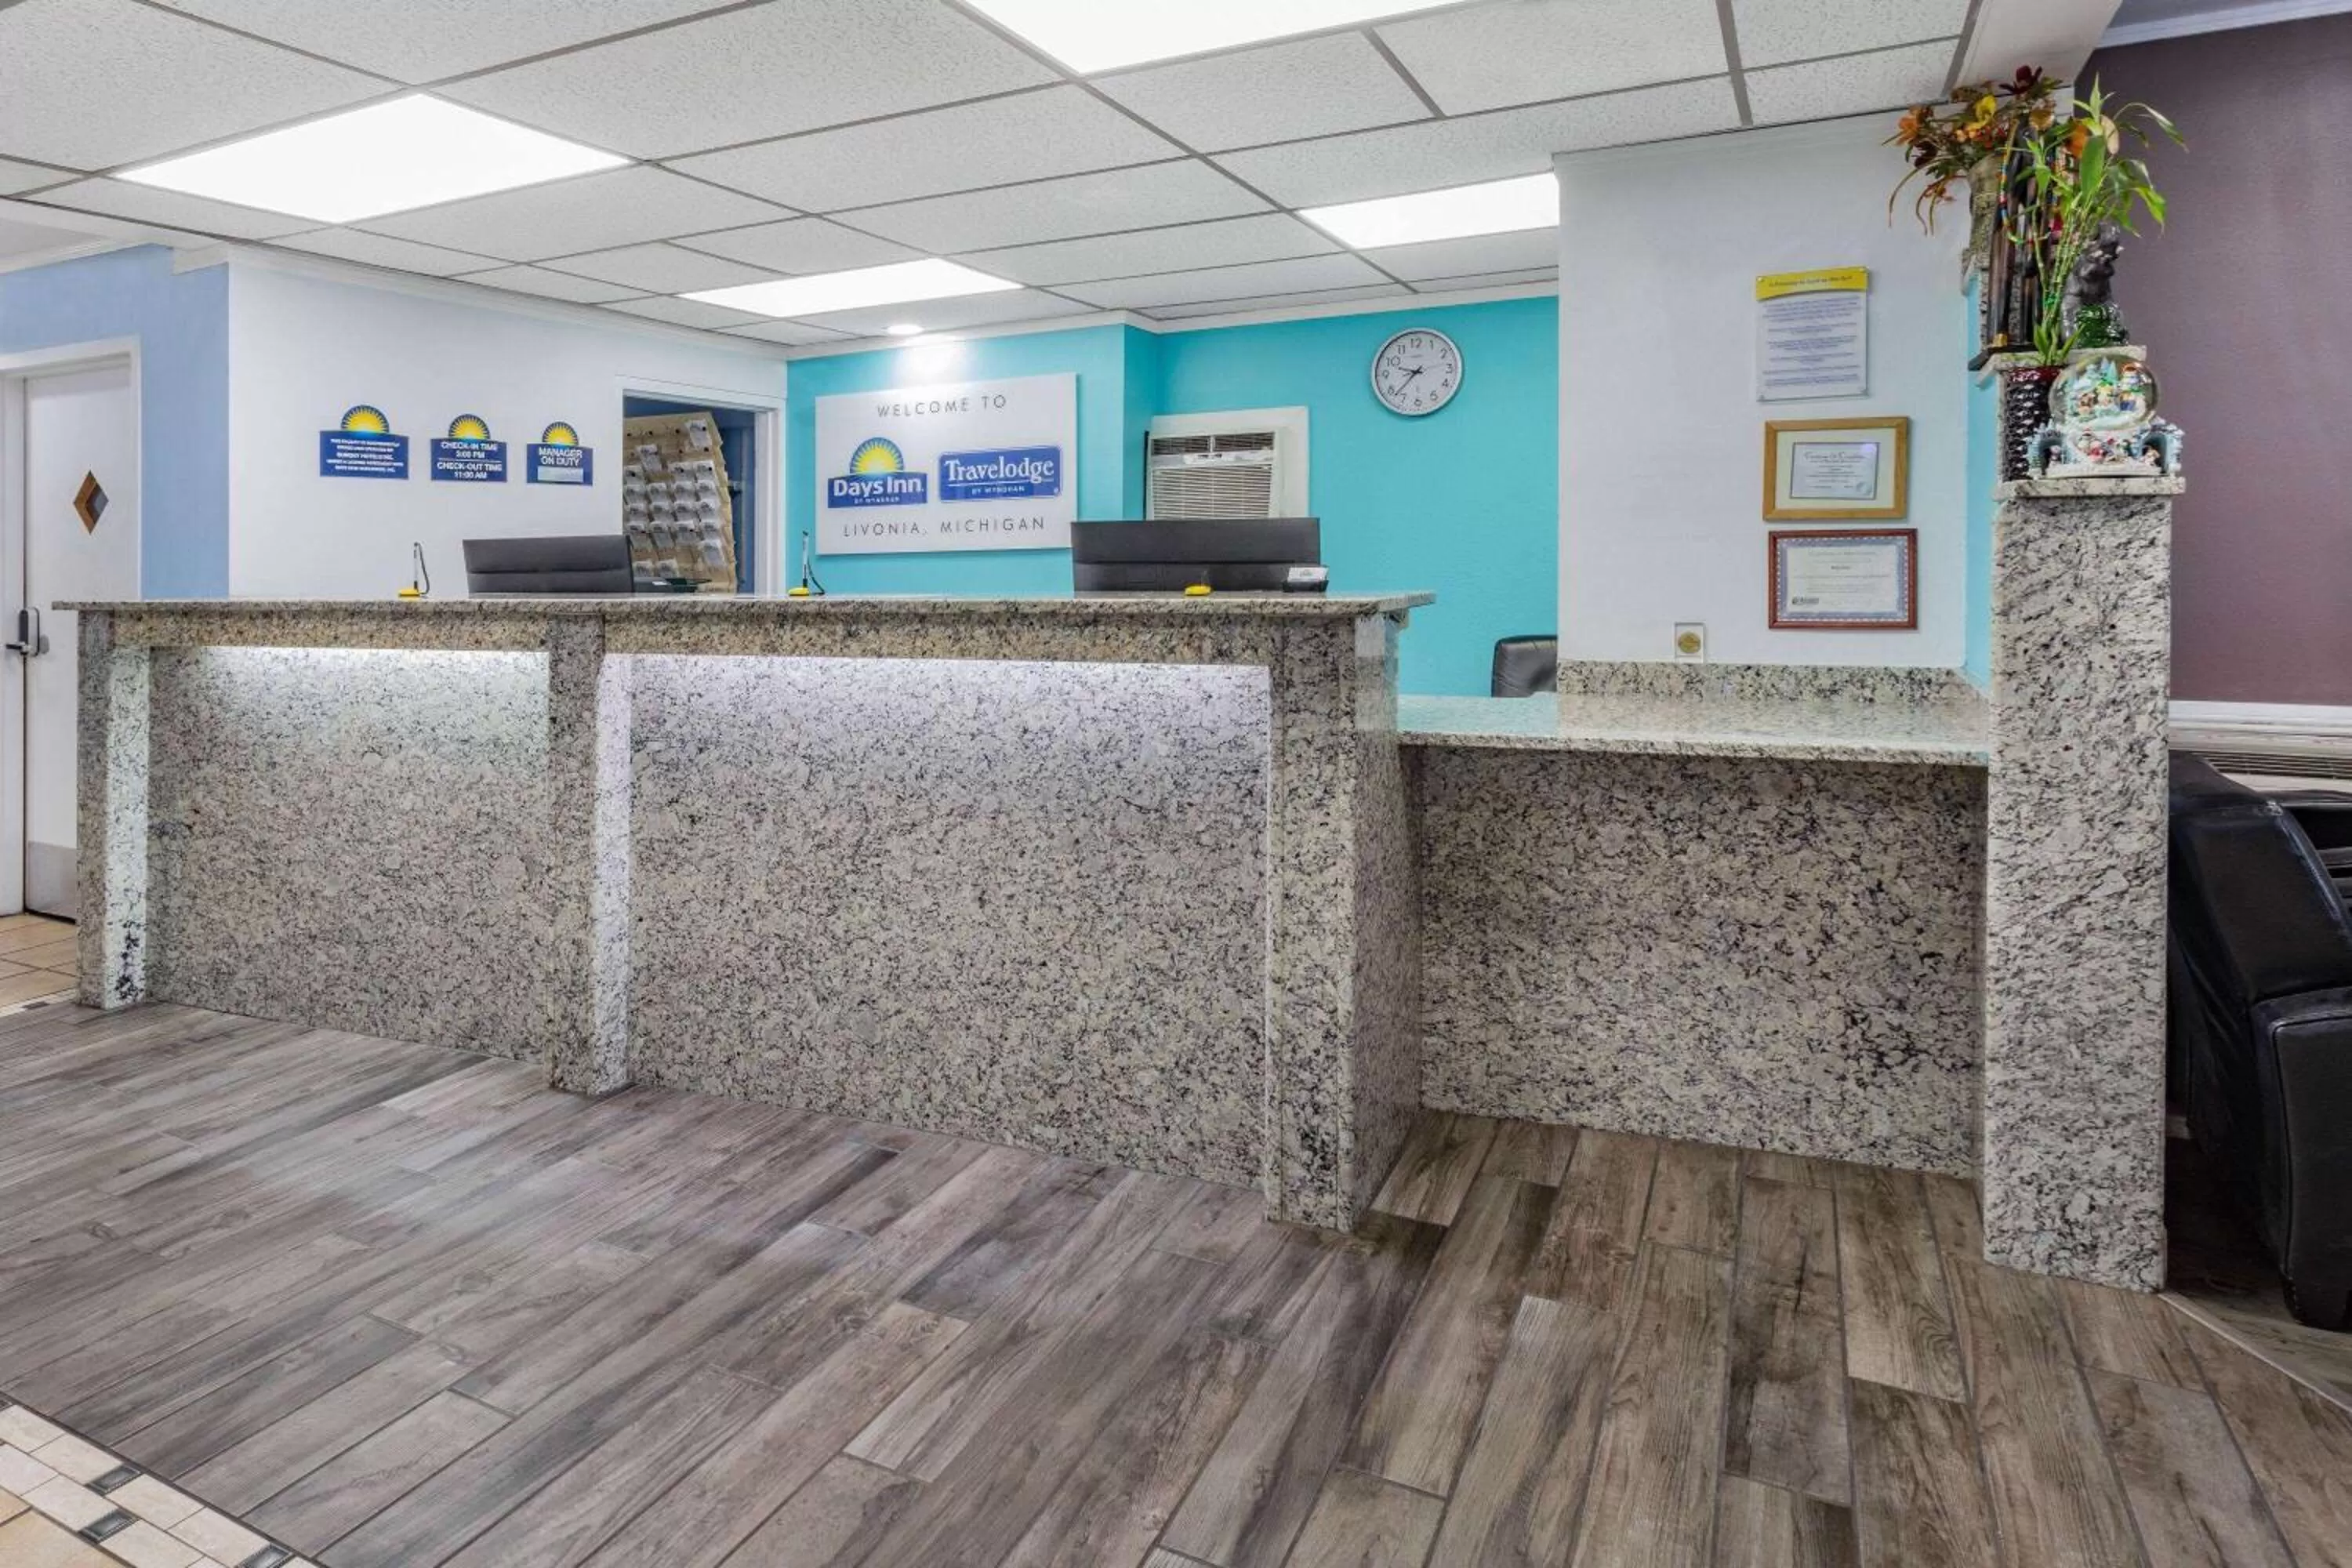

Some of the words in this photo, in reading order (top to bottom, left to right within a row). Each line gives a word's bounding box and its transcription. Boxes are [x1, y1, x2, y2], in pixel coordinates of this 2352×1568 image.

[1410, 337, 1422, 348] 12
[1398, 345, 1406, 354] 11
[1386, 356, 1401, 367] 10
[1382, 369, 1390, 379] 9
[1446, 363, 1453, 374] 3
[1442, 378, 1450, 388] 4
[1399, 392, 1407, 404] 7
[877, 397, 970, 418] WELCOME
[981, 394, 1007, 410] TO
[539, 446, 583, 458] MANAGER
[437, 461, 483, 471] CHECK-OUT
[484, 463, 503, 471] TIME
[541, 456, 554, 465] ON
[556, 456, 580, 466] DUTY
[943, 456, 1054, 484] Travelodge
[833, 478, 884, 498] Days
[887, 475, 921, 494] Inn
[940, 517, 1045, 533] MICHIGAN
